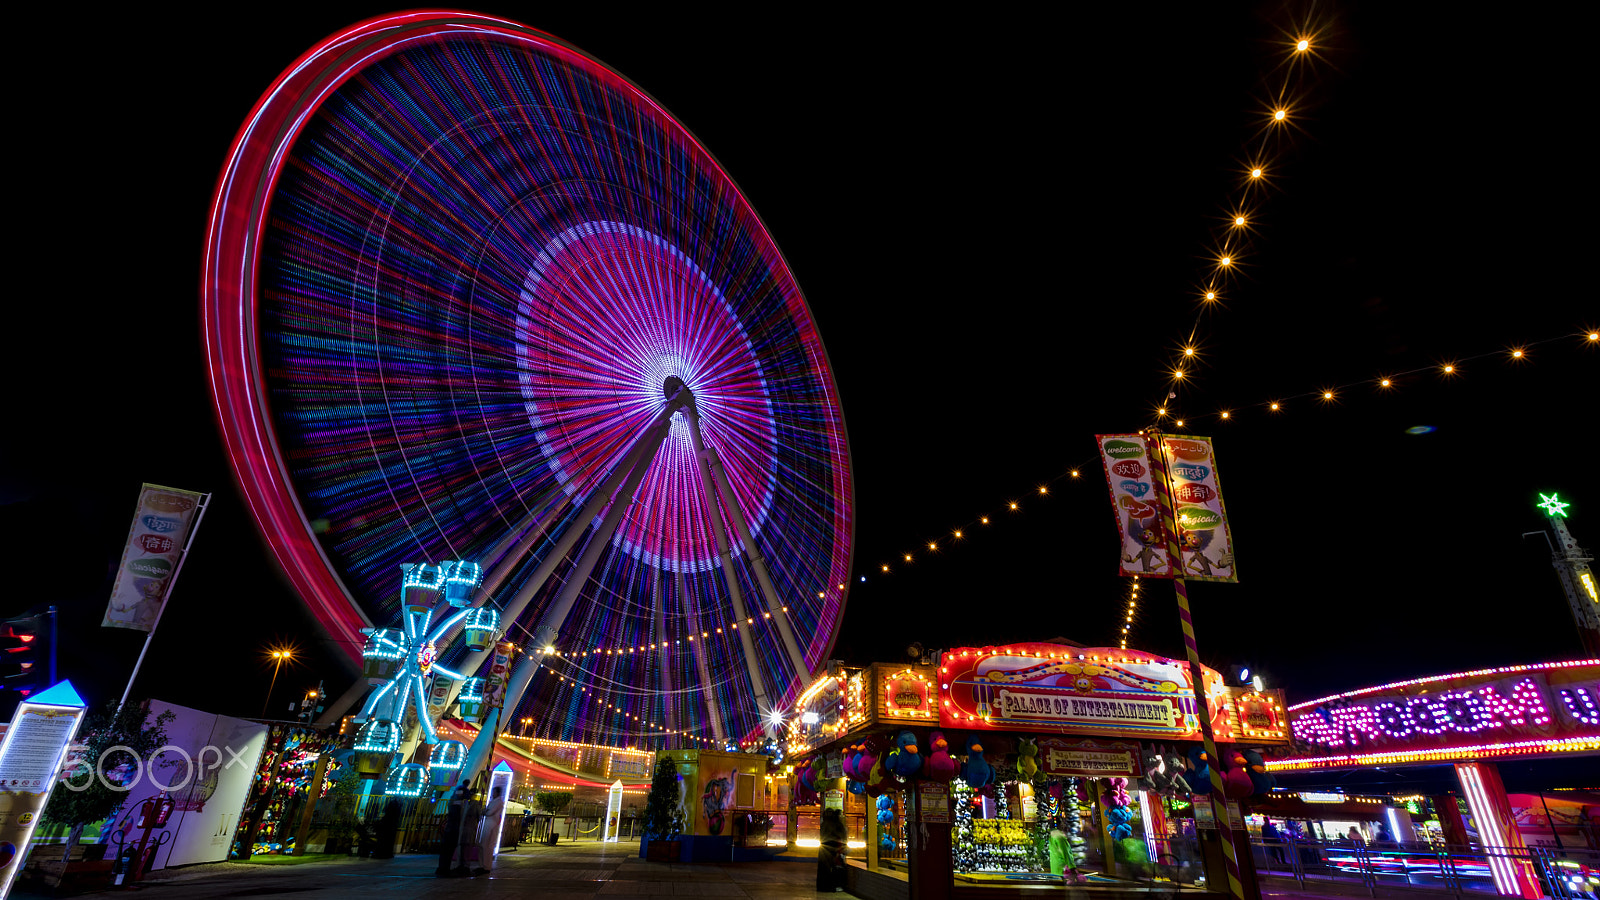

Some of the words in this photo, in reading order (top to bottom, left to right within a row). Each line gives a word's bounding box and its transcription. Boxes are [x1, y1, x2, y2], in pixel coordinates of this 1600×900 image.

[1116, 463, 1141, 476] 欢迎
[1176, 486, 1210, 500] 神奇!
[1005, 696, 1052, 714] PALACE
[1053, 699, 1069, 716] OF
[1071, 699, 1169, 721] ENTERTAINMENT
[1055, 759, 1081, 769] PRIZE
